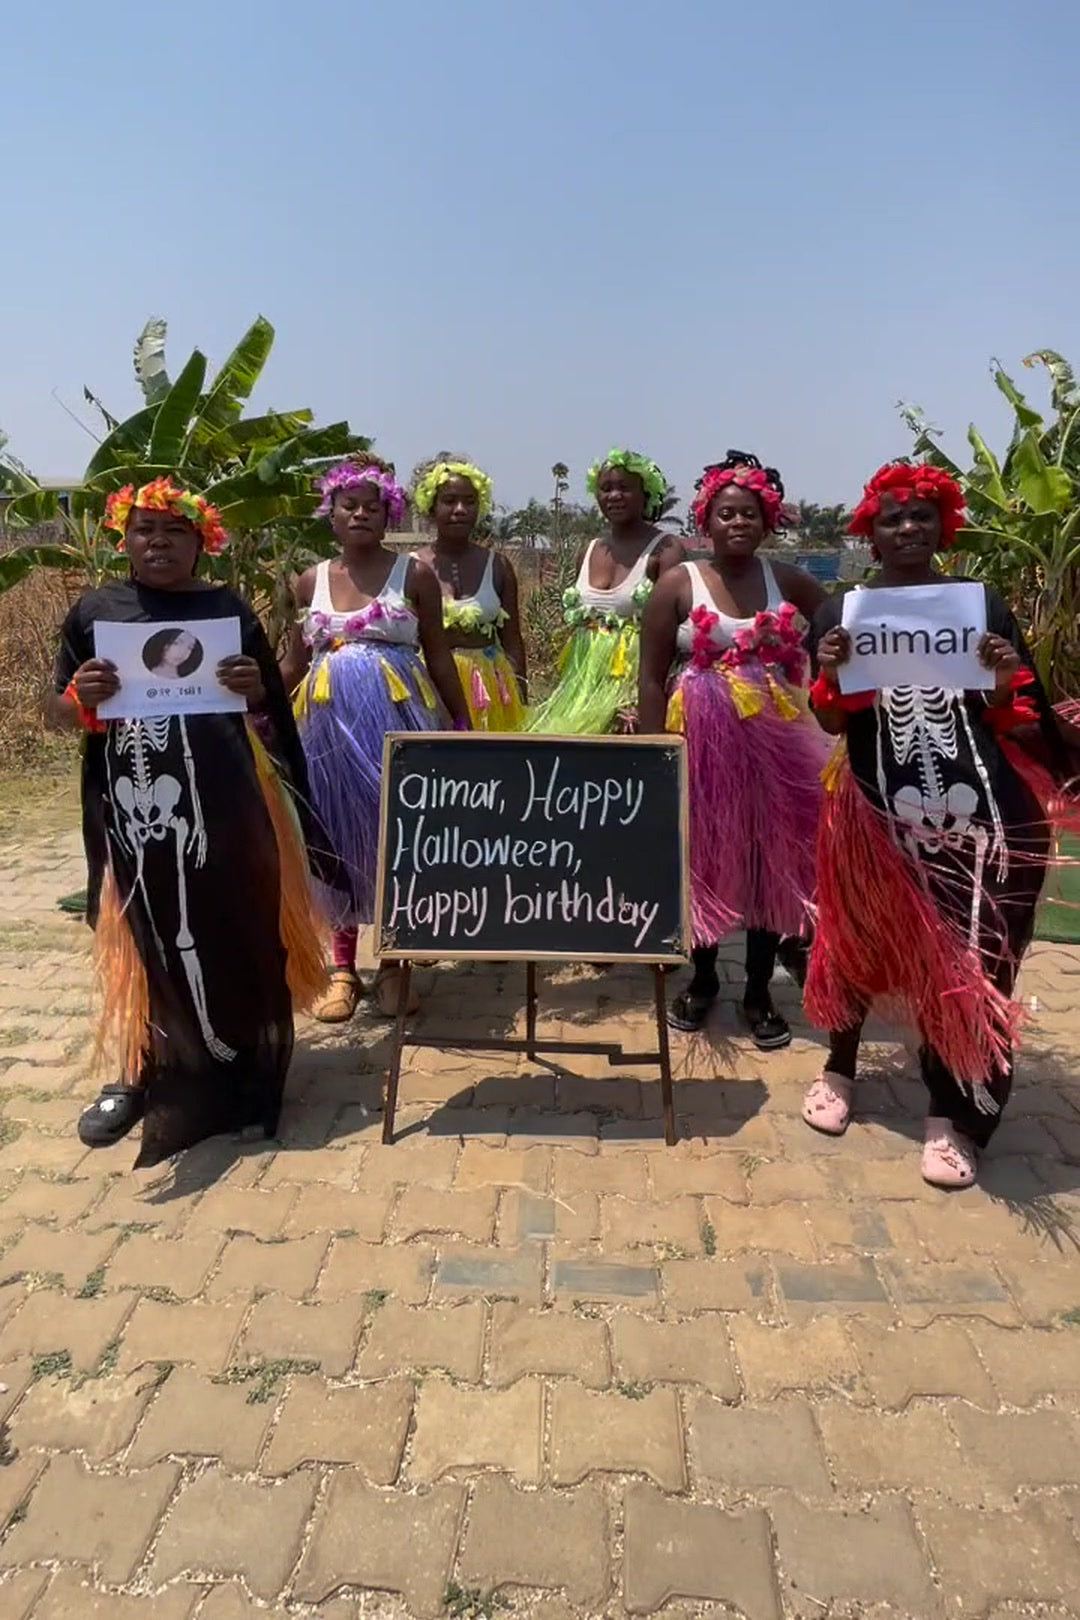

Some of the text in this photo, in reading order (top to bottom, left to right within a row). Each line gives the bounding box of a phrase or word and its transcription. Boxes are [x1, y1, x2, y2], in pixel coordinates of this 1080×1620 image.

[855, 623, 976, 656] aimar
[399, 756, 644, 830] aimar, Happy
[392, 815, 582, 876] Halloween,
[389, 872, 660, 948] Happy birthday
